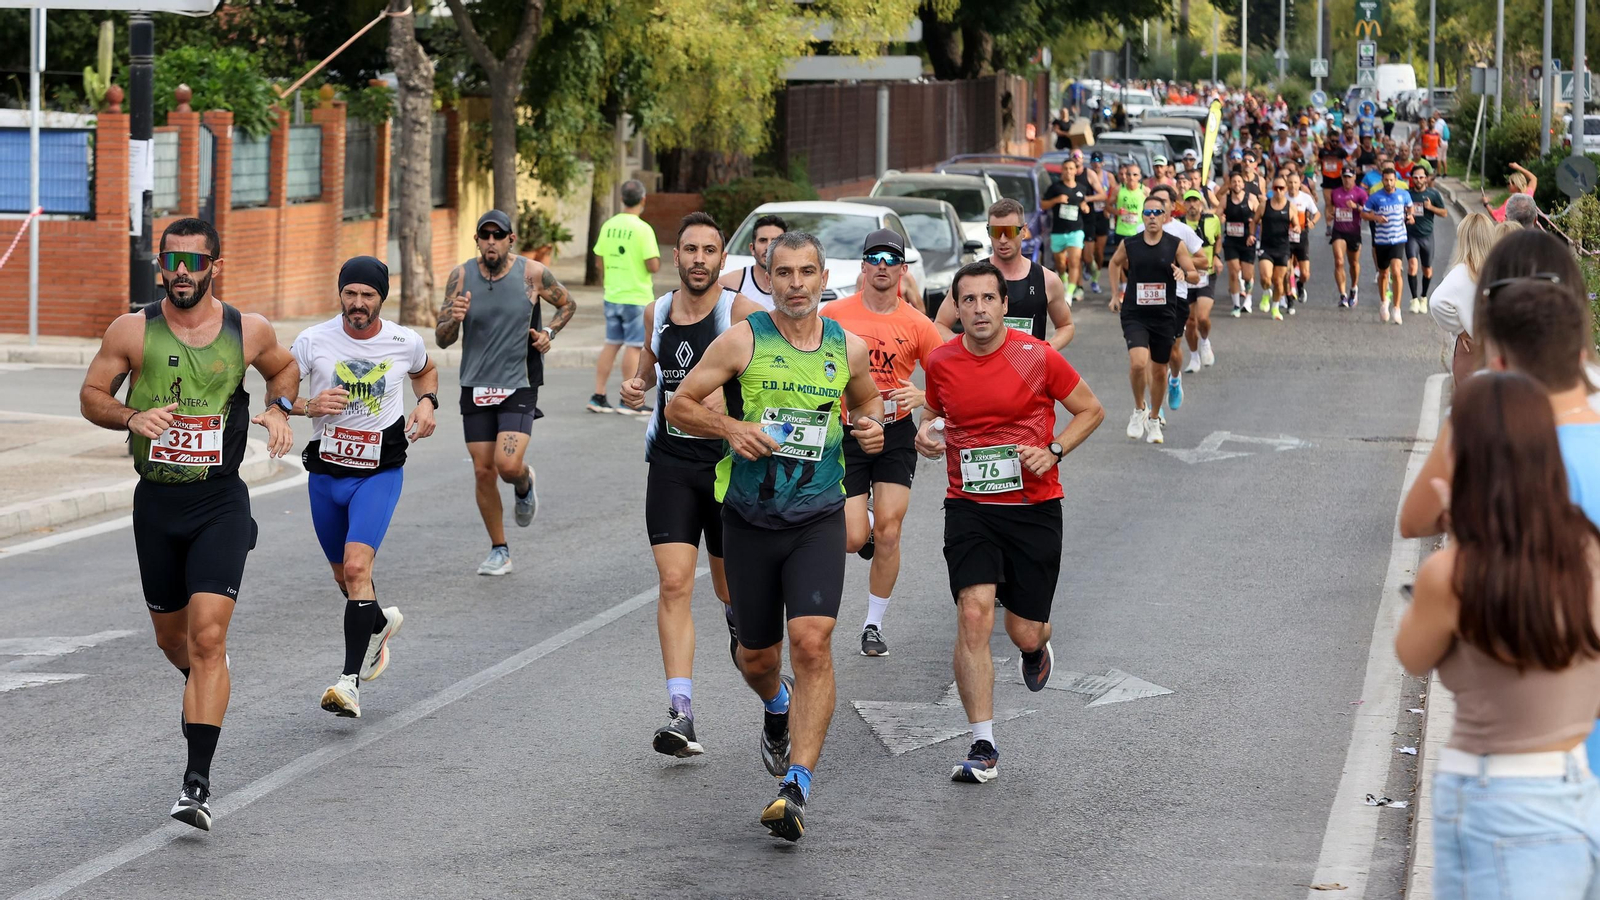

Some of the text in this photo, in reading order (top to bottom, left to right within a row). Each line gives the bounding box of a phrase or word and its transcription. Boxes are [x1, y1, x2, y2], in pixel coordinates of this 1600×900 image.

[607, 228, 632, 240] STAFF
[1144, 290, 1160, 298] 538
[762, 380, 841, 399] C.D. LA MOLINERA
[162, 396, 208, 408] MONTERA
[168, 429, 203, 450] 321
[335, 441, 366, 458] 167
[978, 463, 1000, 479] 76
